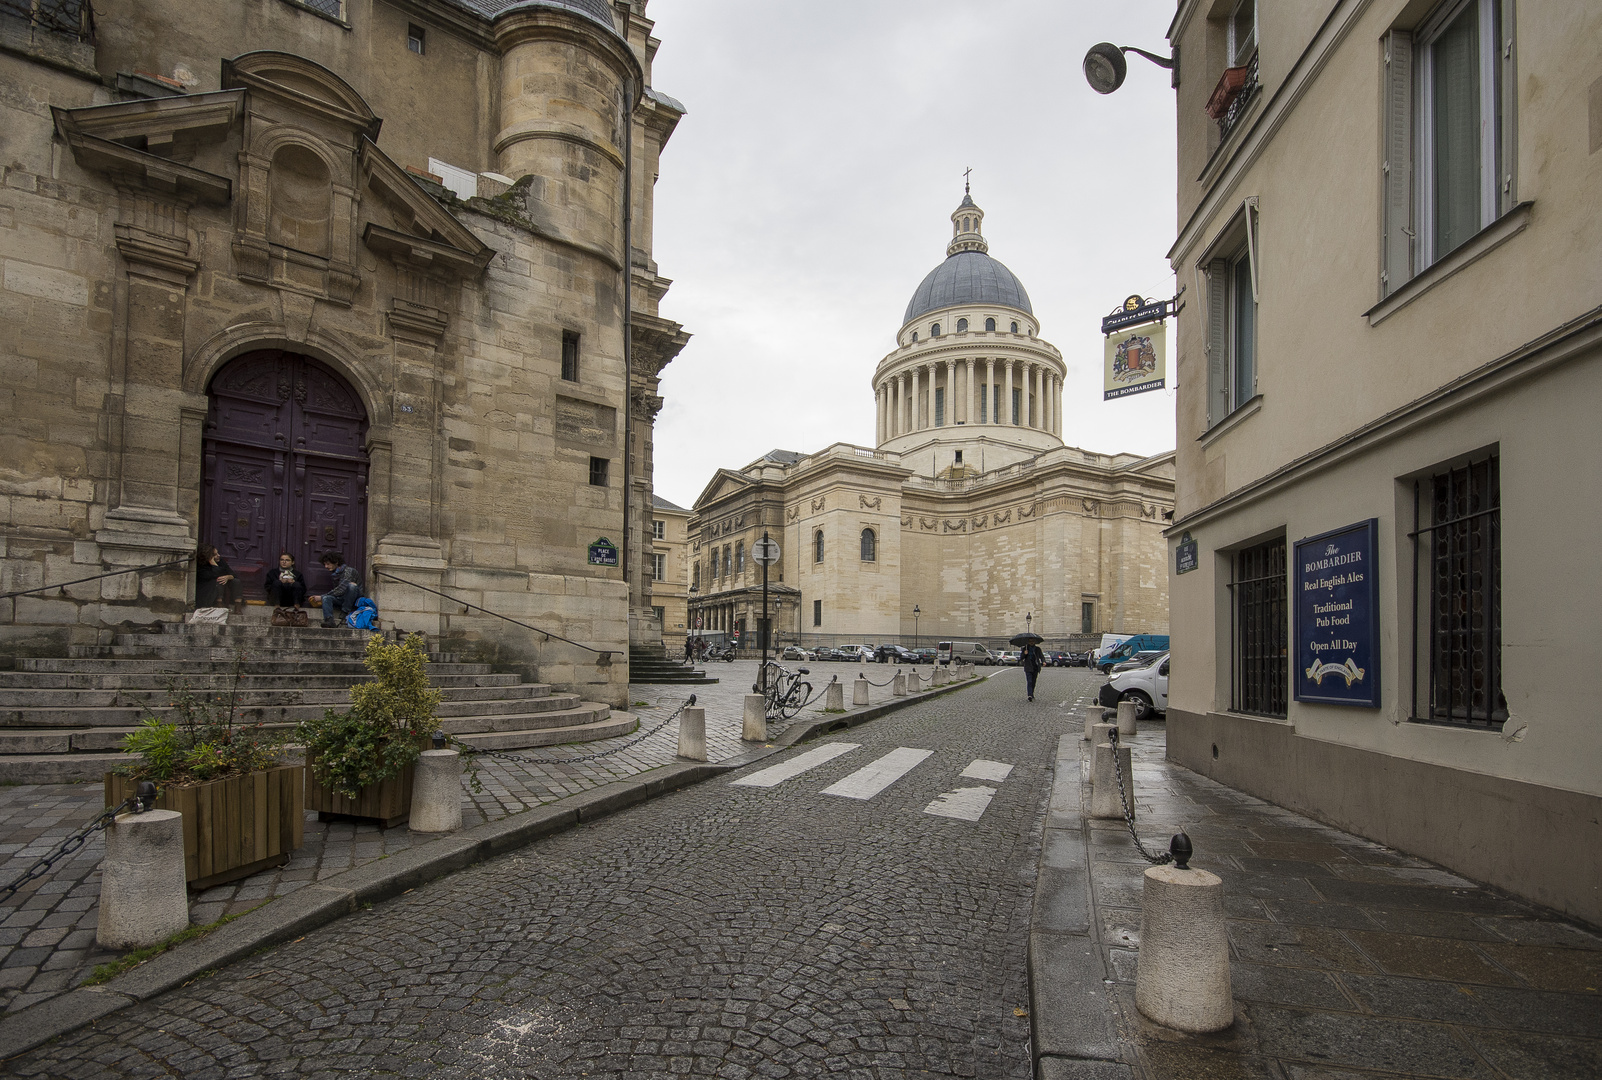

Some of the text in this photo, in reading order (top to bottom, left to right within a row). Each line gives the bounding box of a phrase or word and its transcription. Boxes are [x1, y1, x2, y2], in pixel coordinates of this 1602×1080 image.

[1106, 381, 1162, 398] THE BOMBARDIER
[1324, 544, 1340, 556] The
[1305, 551, 1362, 573] BOMBARDIER
[1304, 571, 1364, 591] Real English Ales
[1312, 598, 1353, 614] Traditional
[1316, 614, 1350, 628] Pub Food
[1310, 639, 1358, 655] Open All Day
